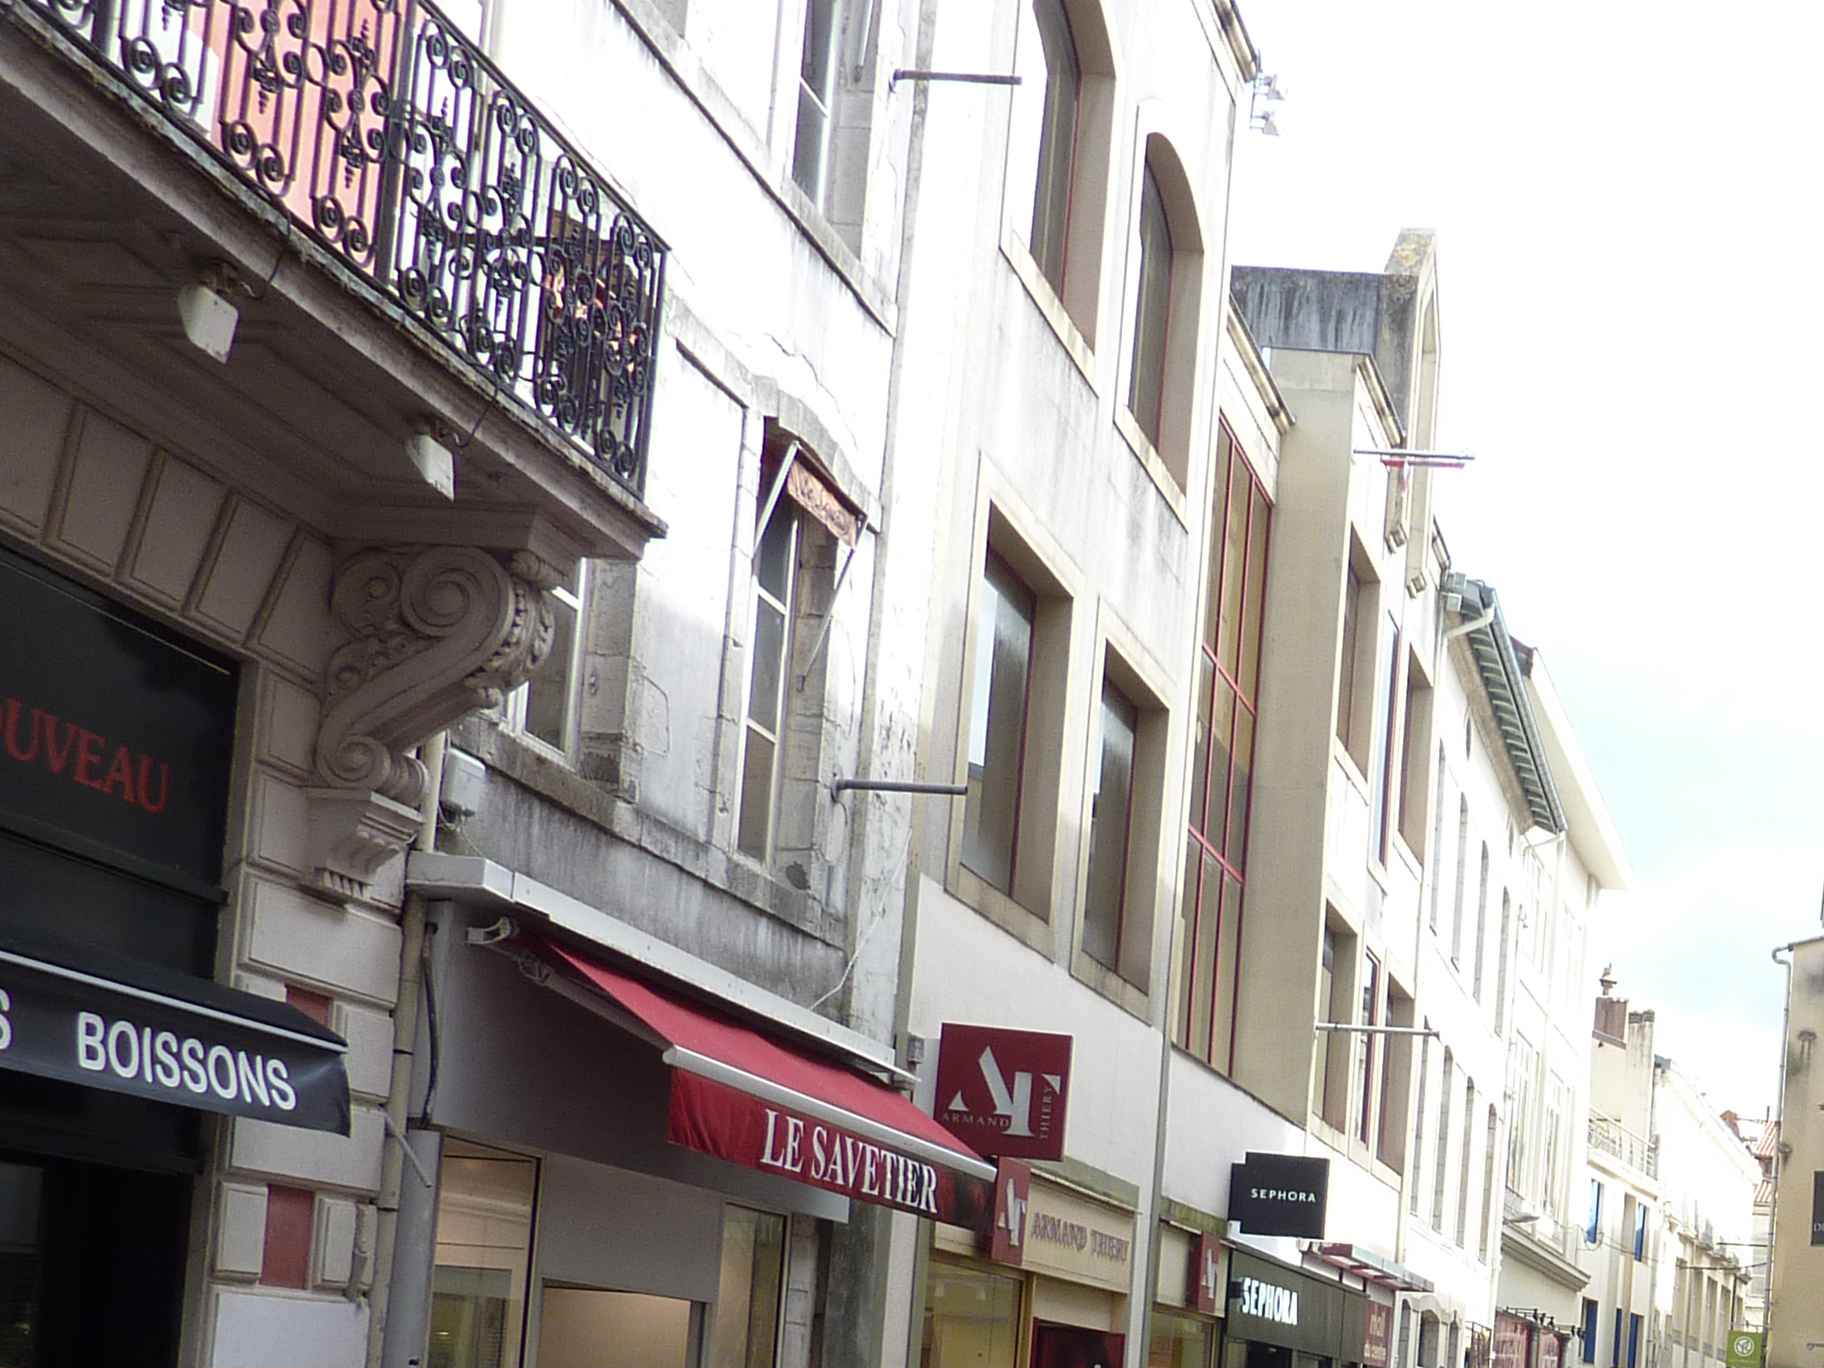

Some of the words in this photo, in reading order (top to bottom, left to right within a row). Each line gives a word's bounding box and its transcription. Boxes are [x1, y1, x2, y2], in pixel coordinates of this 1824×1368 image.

[0, 697, 171, 813] UVEAU
[78, 1011, 296, 1110] BOISSONS
[943, 1111, 1008, 1130] ARMAND
[760, 1108, 804, 1172] LE
[811, 1126, 938, 1213] SAVETIER
[1250, 1188, 1316, 1203] SEPHORA
[1031, 1211, 1088, 1251] ARMAND
[1242, 1276, 1299, 1326] SEPHORA
